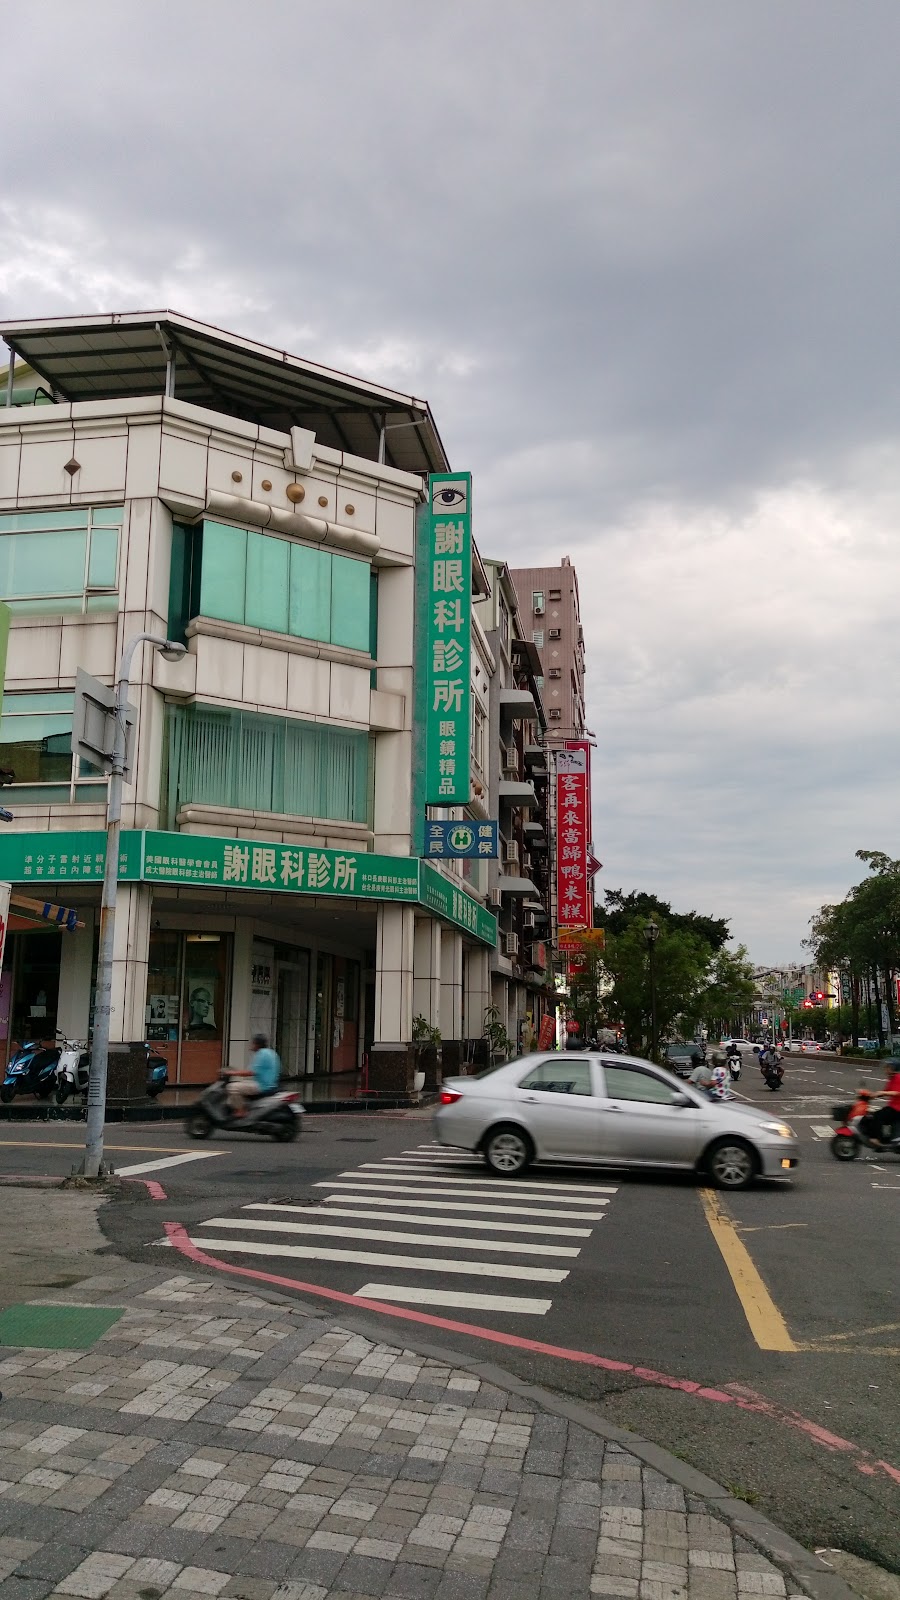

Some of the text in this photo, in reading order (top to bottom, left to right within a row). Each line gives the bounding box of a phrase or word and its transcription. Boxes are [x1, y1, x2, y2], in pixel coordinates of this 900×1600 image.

[432, 520, 465, 713] 謝眼科診所
[438, 720, 456, 795] 眼鏡精品
[429, 824, 445, 854] 全民
[477, 824, 493, 854] 健保
[23, 864, 128, 875] 超音波白內障乳術
[24, 853, 128, 864] 準分子雷射近視術
[222, 845, 358, 891] 謝眼科診所
